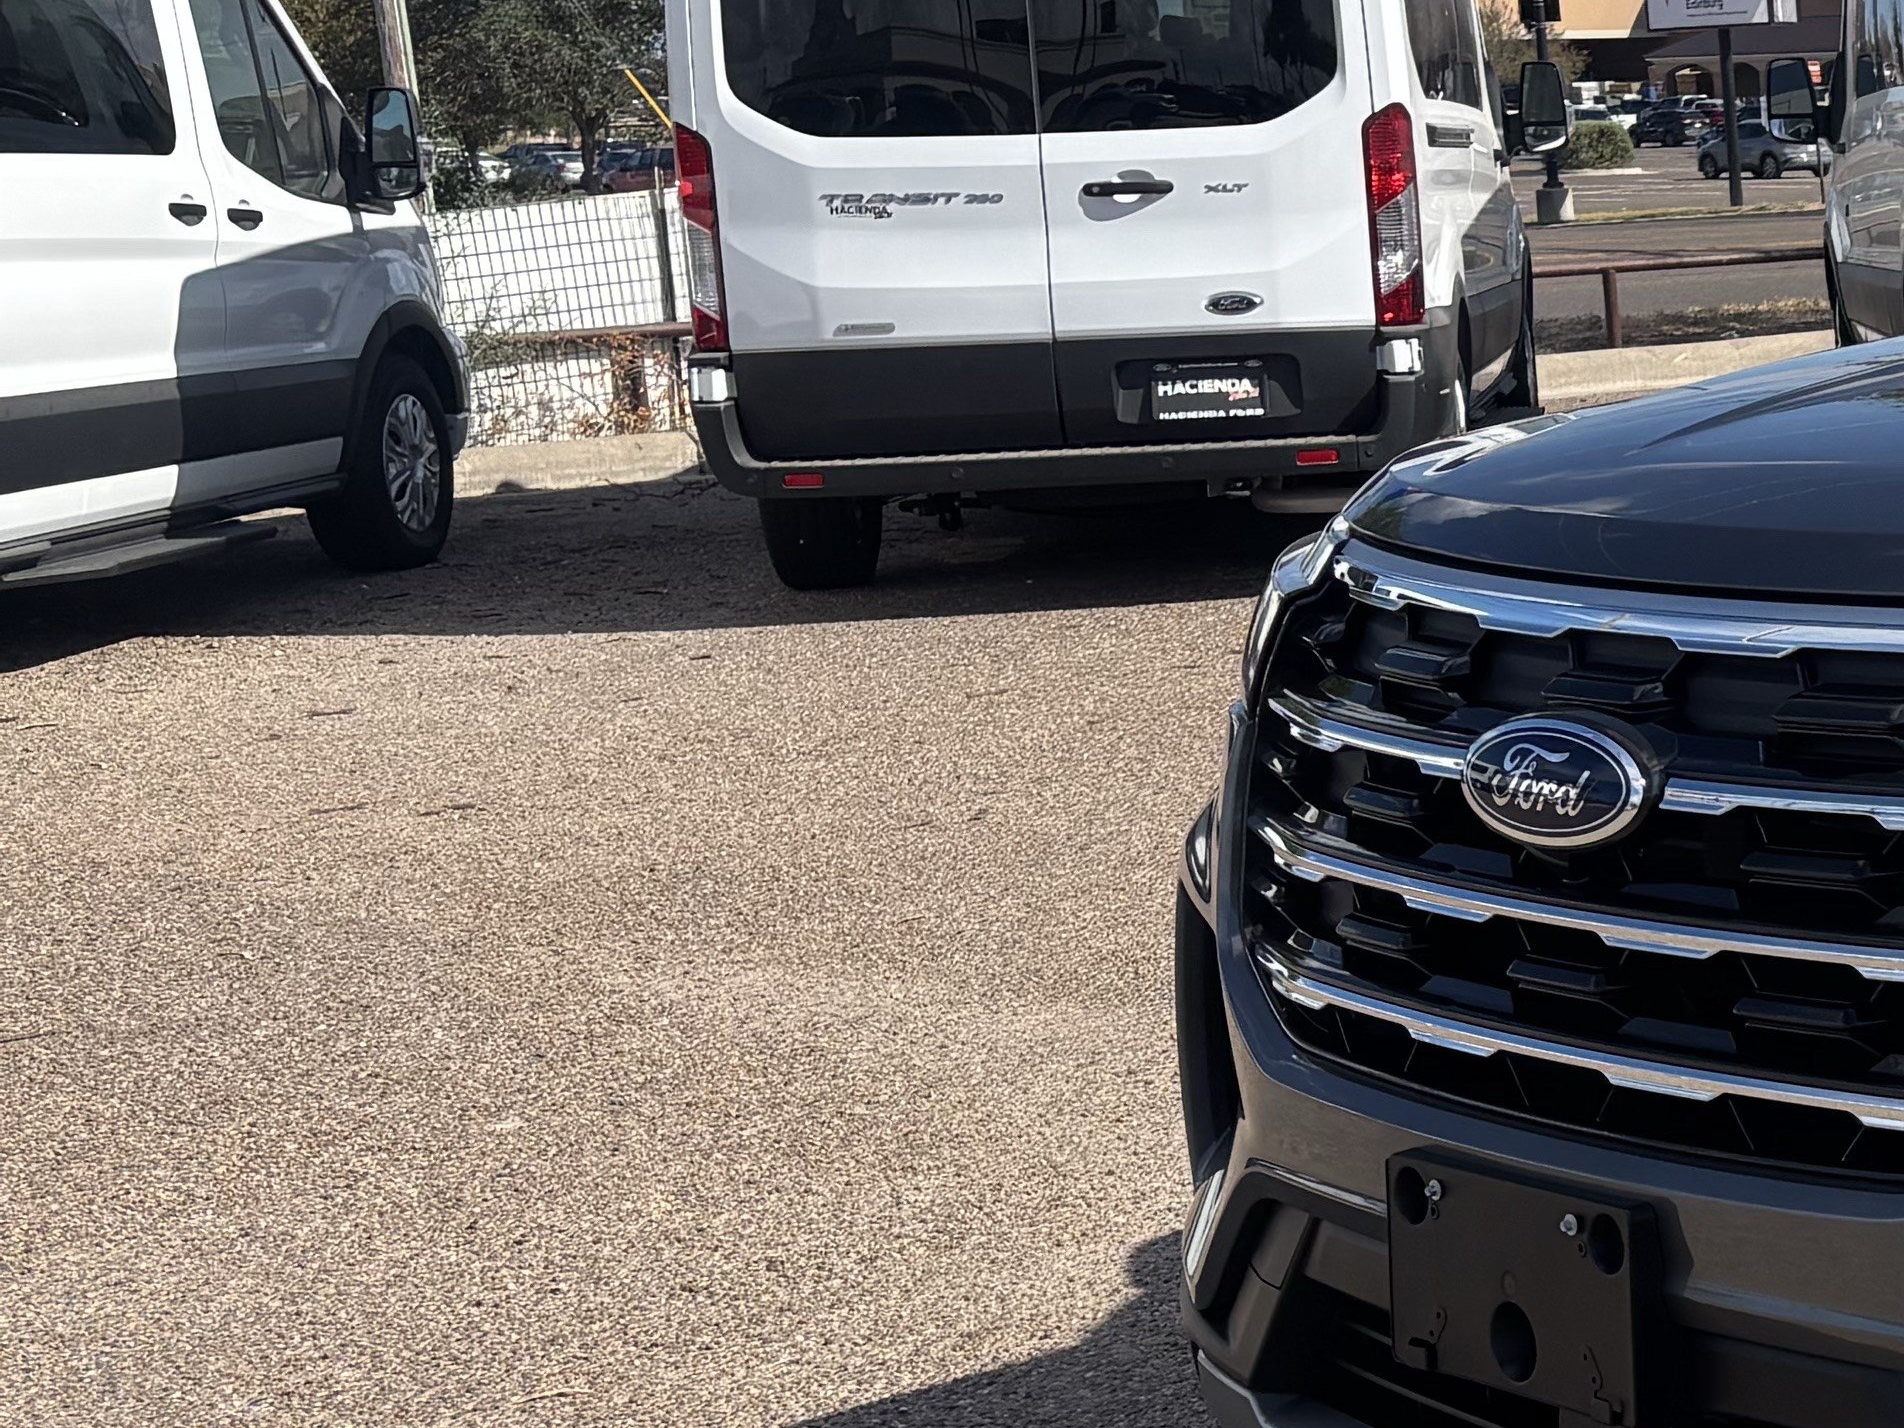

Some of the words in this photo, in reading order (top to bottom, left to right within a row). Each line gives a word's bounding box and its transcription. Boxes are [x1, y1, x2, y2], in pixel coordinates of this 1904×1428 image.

[1203, 182, 1250, 195] XLT
[818, 191, 961, 207] TRANSIT
[829, 205, 889, 216] HACIENDA
[1157, 377, 1253, 397] HACIENDA
[1159, 409, 1227, 421] HACIENDA
[1490, 742, 1596, 818] Ford
